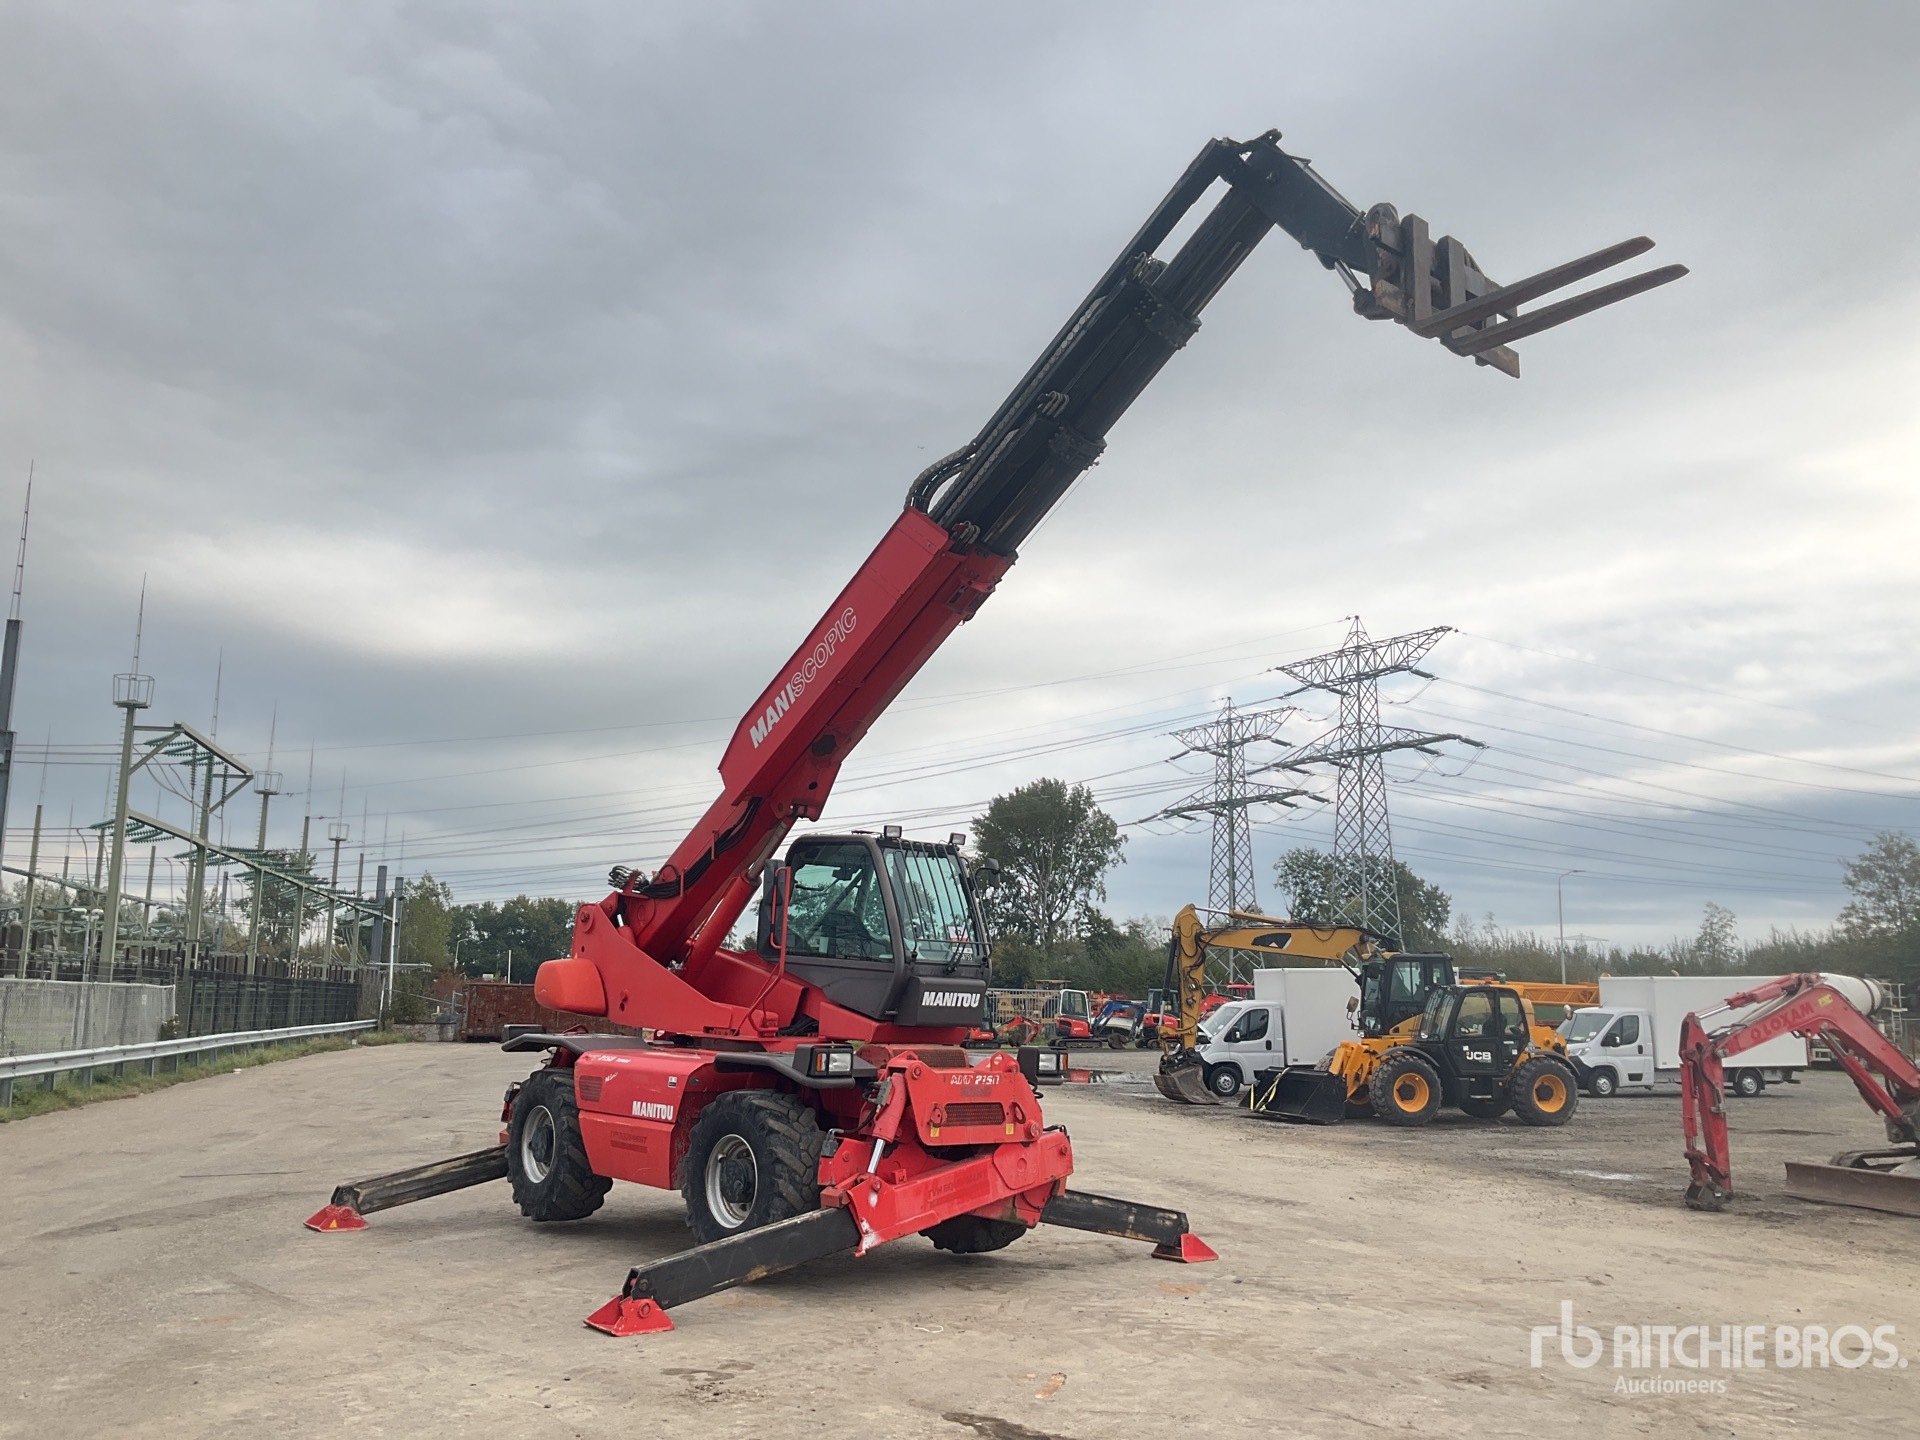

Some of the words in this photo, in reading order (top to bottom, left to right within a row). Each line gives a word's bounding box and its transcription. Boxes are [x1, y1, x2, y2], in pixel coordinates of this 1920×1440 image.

[750, 607, 856, 749] MANISCOPIC
[921, 991, 980, 1007] MANITOU
[1466, 1051, 1491, 1060] JCB
[632, 1100, 674, 1121] MANITOU
